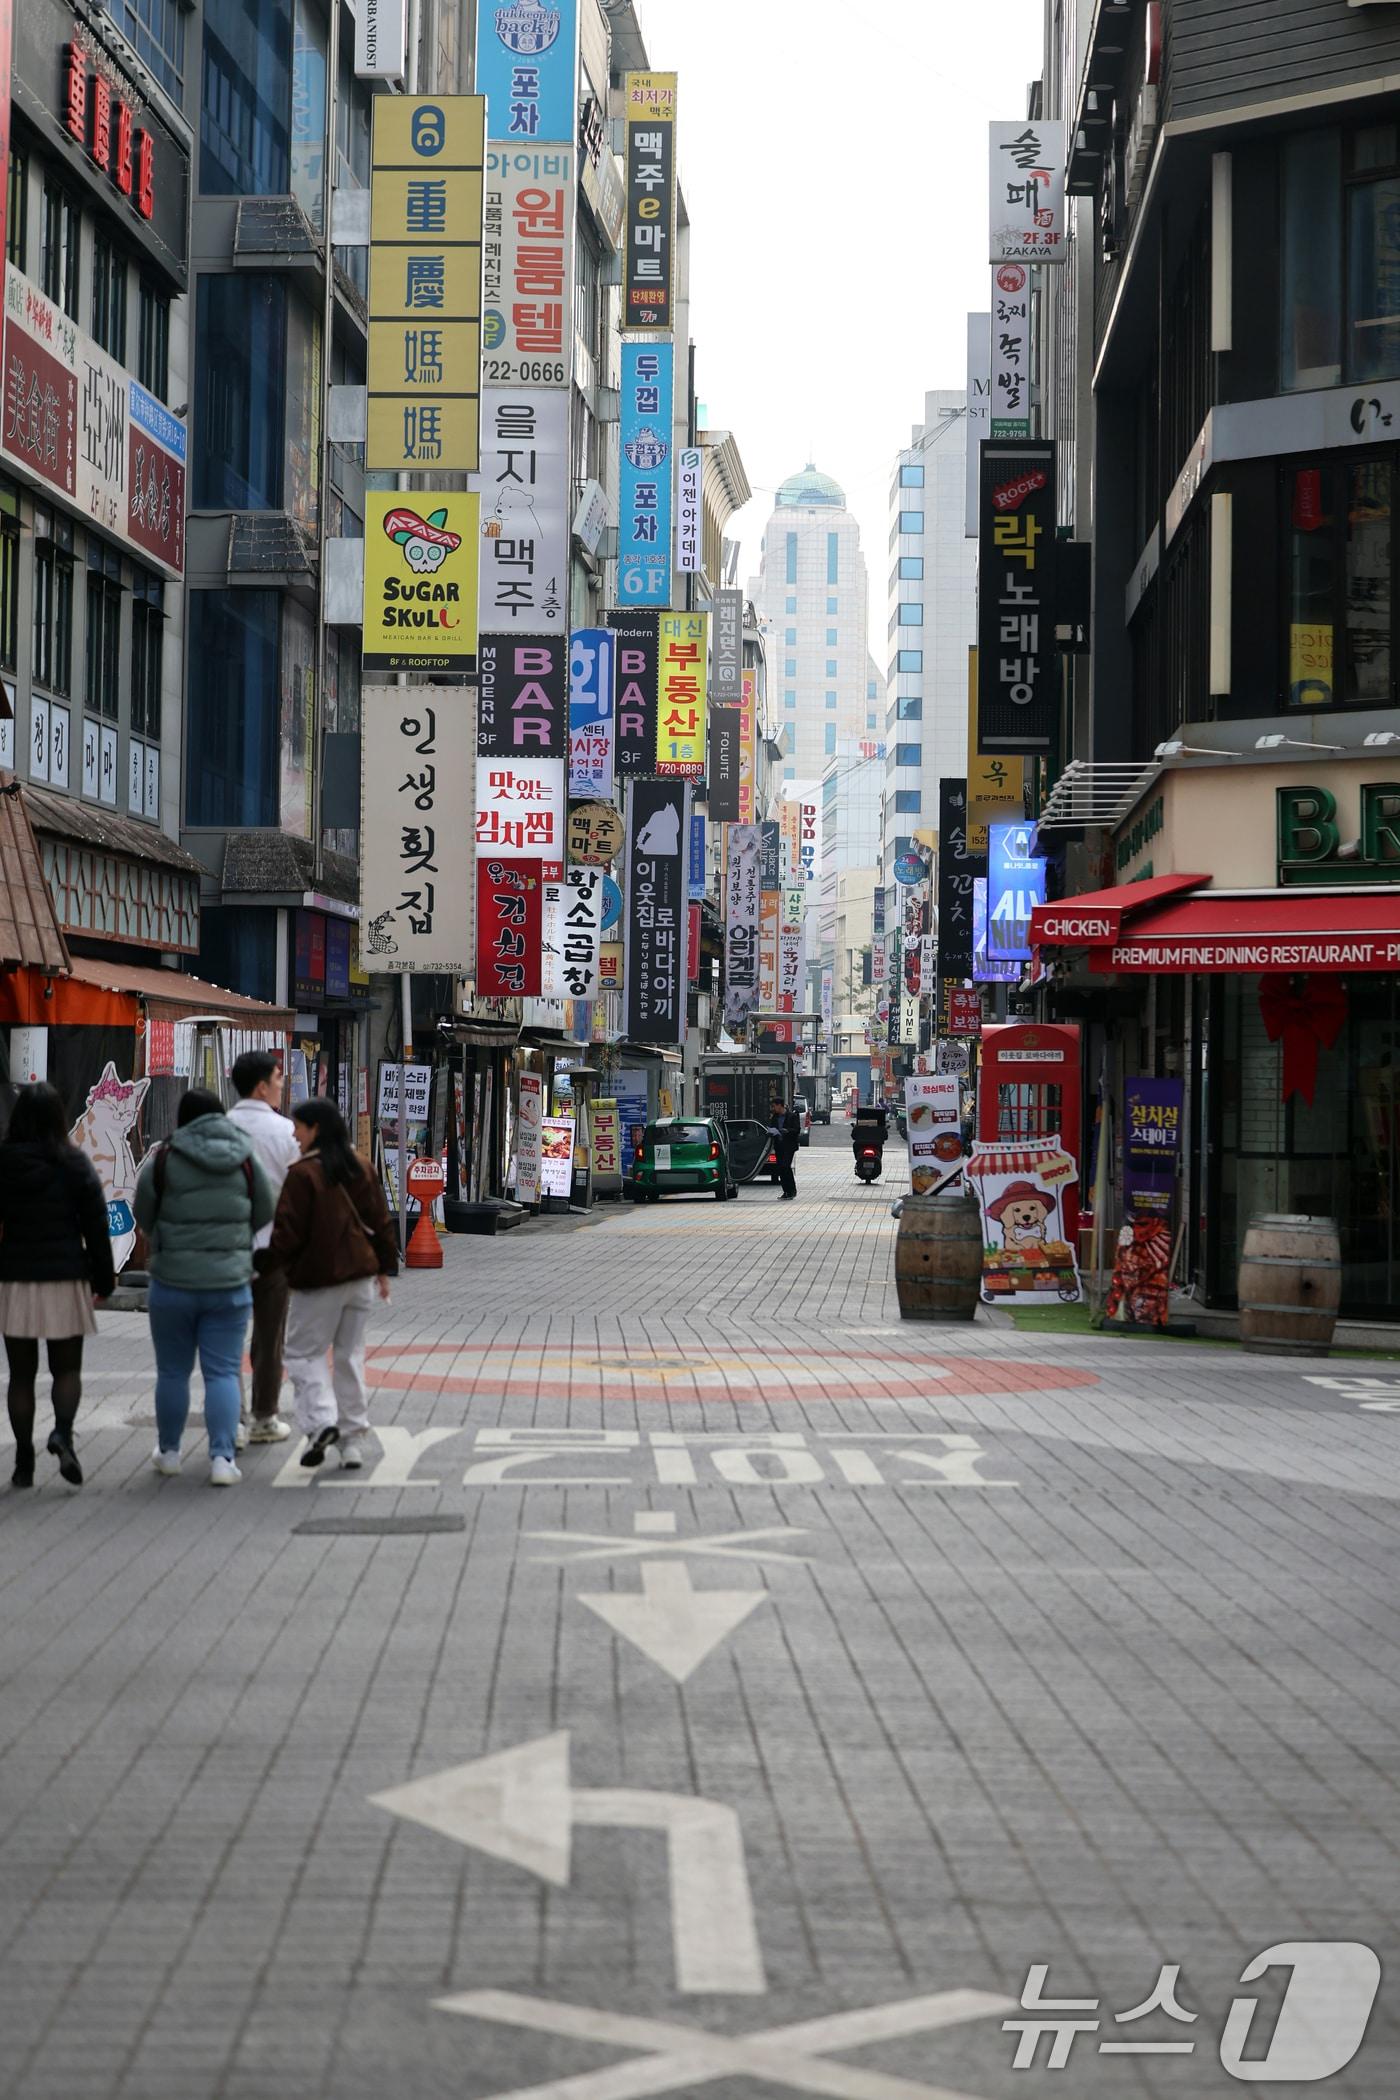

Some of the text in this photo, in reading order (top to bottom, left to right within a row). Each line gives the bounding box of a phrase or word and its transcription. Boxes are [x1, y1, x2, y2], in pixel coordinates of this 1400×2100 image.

[496, 18, 555, 34] back!
[631, 79, 651, 89] 국내
[631, 89, 674, 105] 최저가
[511, 66, 540, 135] 포차
[649, 106, 673, 117] 맥주
[634, 132, 666, 281] 맥주e마트
[1002, 247, 1051, 256] IZAKAYA
[512, 189, 567, 354] 원룸텔
[632, 290, 666, 304] 단체환영
[403, 180, 448, 460] 重慶媽媽
[484, 360, 565, 383] 722-0666
[997, 333, 1026, 409] 족발
[633, 355, 661, 544] 두껍 포차
[996, 478, 1038, 507] ROCK
[494, 404, 537, 617] 을지 맥주
[623, 568, 666, 594] 6F
[540, 577, 562, 618] 4층
[993, 514, 1043, 705] 락 노래방
[614, 628, 654, 638] Modern
[664, 620, 704, 640] 대신
[719, 606, 737, 663] 레지던스
[409, 657, 450, 668] ROOFTOP
[482, 646, 497, 725] MODERN
[511, 646, 555, 746] BAR
[618, 649, 648, 737] BAR
[662, 642, 701, 738] 부동산
[478, 732, 498, 746] 3F
[582, 725, 605, 738] 센터
[569, 738, 610, 758] 시장
[620, 750, 641, 764] 3F
[667, 742, 694, 759] 1층
[721, 732, 730, 780] FOLUITE
[569, 769, 603, 780] 산물
[659, 763, 703, 775] 720-0889
[489, 771, 553, 801] 맛있는
[395, 707, 439, 935] 인생횟집
[476, 811, 553, 849] 김치찜
[573, 818, 615, 836] 맥주
[803, 805, 816, 840] DVD
[572, 838, 613, 854] 마트
[972, 837, 988, 846] 152
[635, 861, 656, 929] 이웃집
[562, 871, 600, 998] 황소곱창
[653, 907, 676, 1021] 로바다야끼
[1112, 947, 1181, 971] PREMIUM
[1215, 946, 1269, 969] DINING
[1271, 944, 1374, 968] RESTAURANT
[953, 994, 981, 1008] 족발
[905, 998, 915, 1036] YUME
[953, 1017, 981, 1031] 보쌈
[385, 1070, 428, 1086] 바스타
[1130, 1105, 1179, 1130] 살치살
[594, 1115, 619, 1172] 부동산
[1129, 1128, 1176, 1146] 스테이크
[414, 1165, 440, 1175] 주차금지
